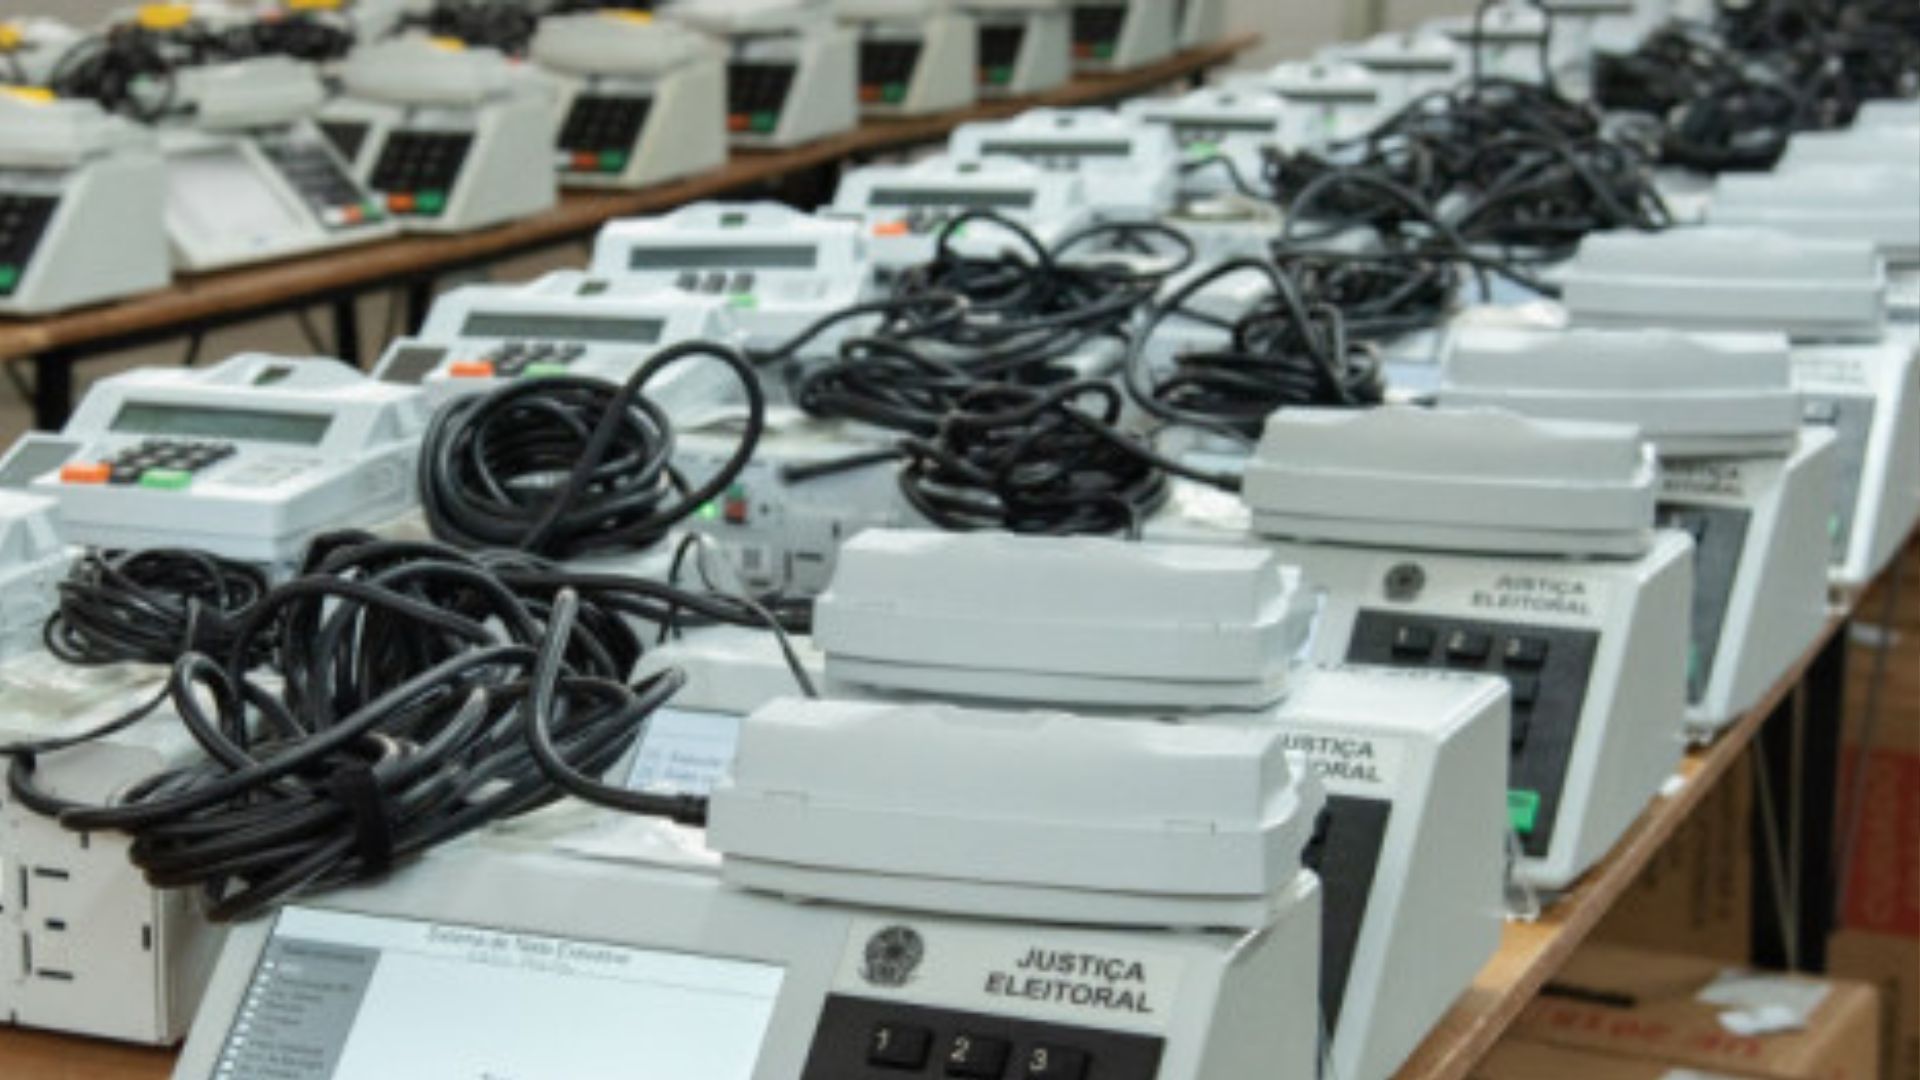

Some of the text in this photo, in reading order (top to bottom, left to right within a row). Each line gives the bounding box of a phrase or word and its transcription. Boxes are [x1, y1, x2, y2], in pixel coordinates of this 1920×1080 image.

[1282, 734, 1373, 759] USTIÇA
[1018, 946, 1145, 982] JUSTIÇA
[985, 973, 1153, 1012] ELEITORAL
[875, 1028, 1048, 1072] 1 2 3
